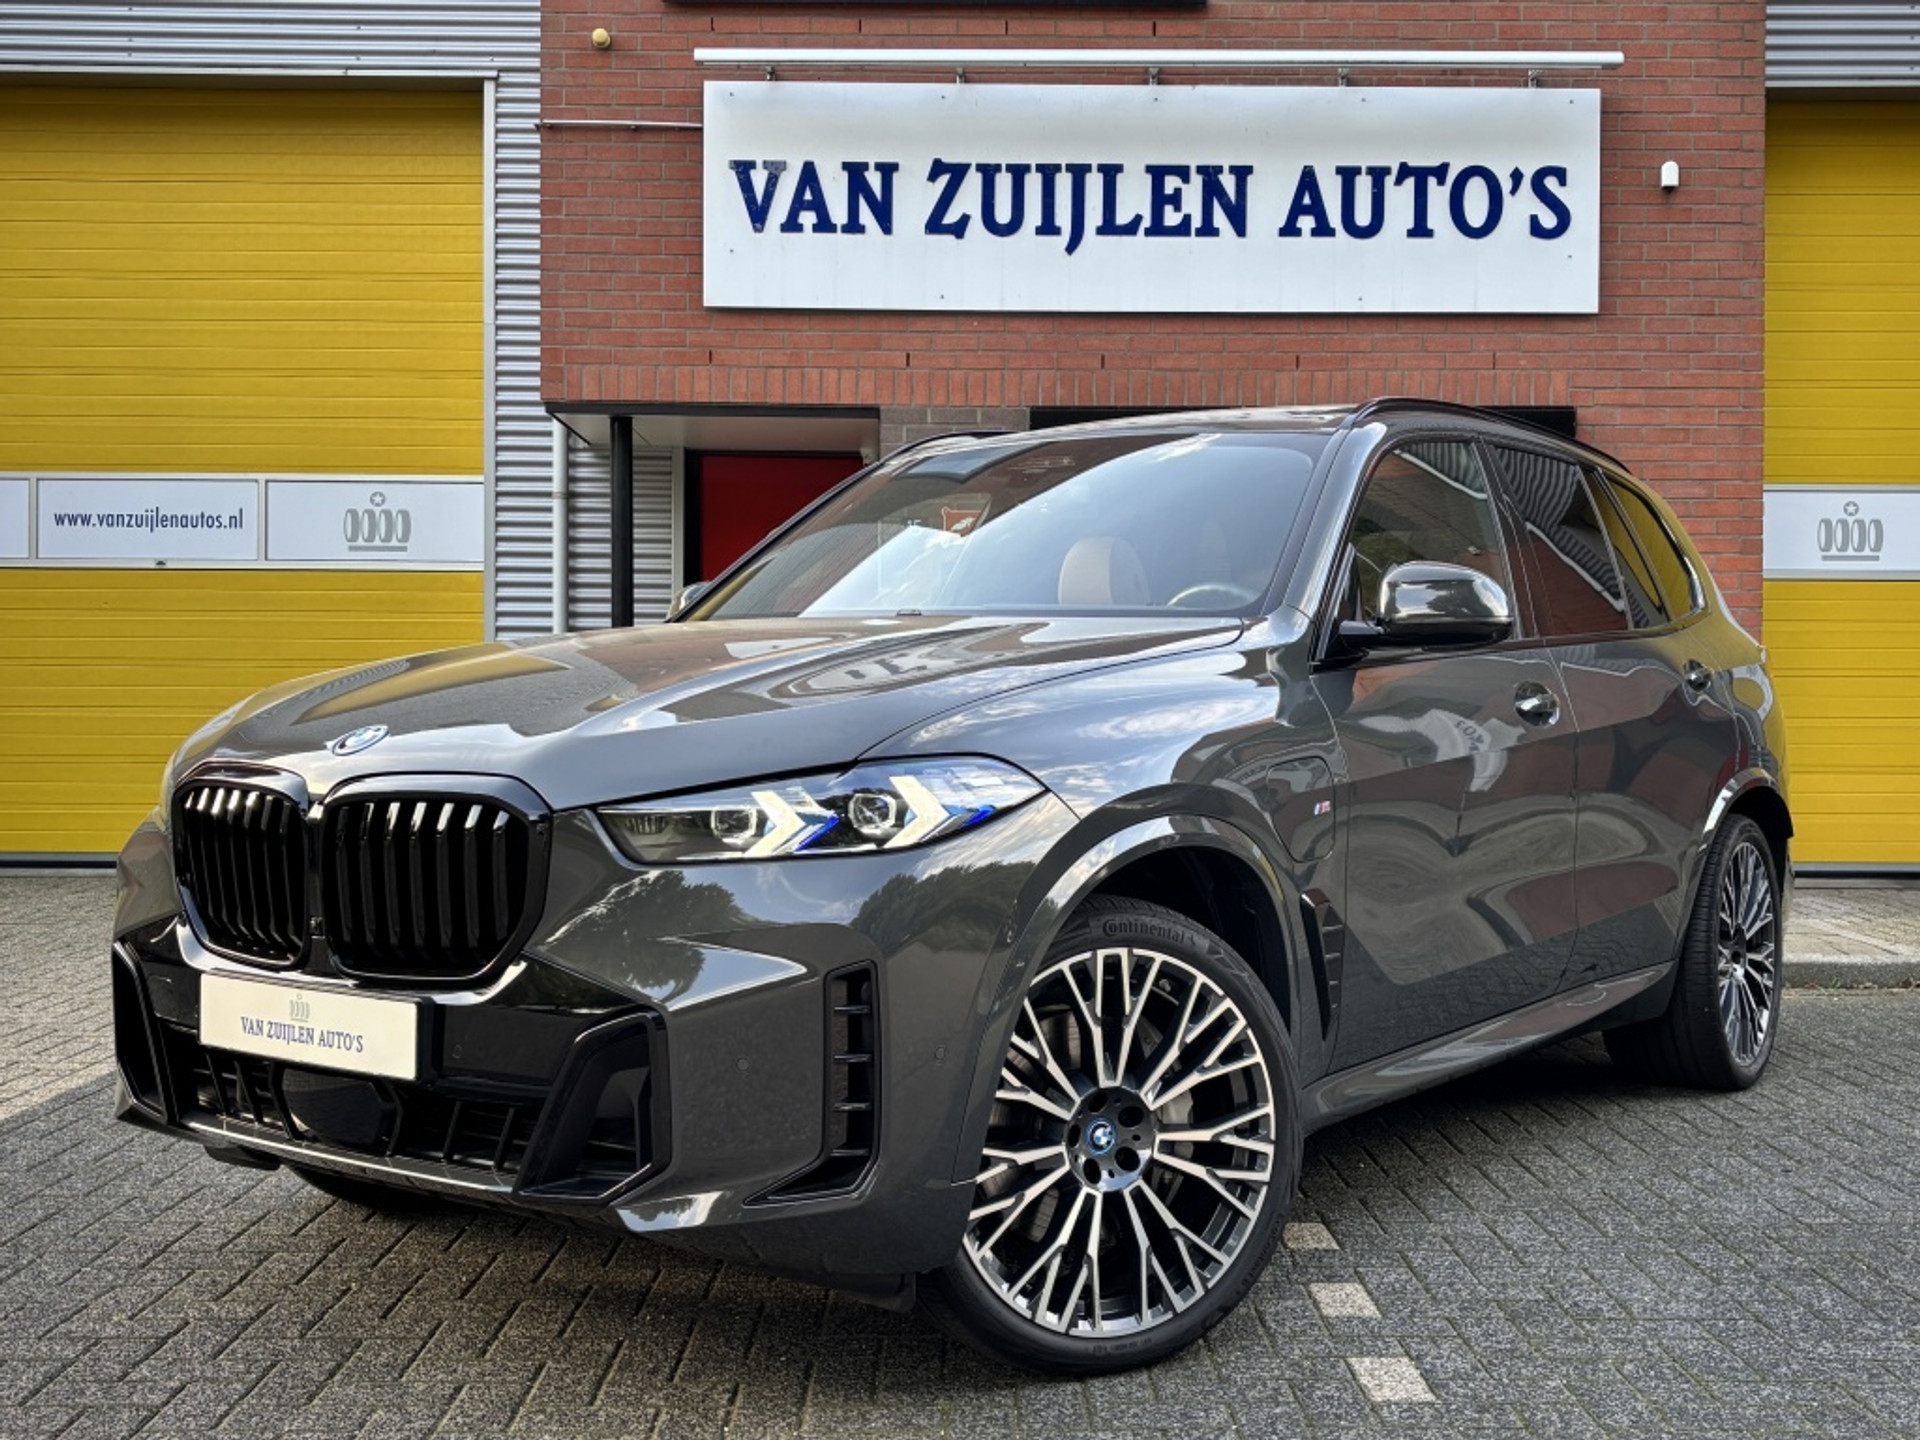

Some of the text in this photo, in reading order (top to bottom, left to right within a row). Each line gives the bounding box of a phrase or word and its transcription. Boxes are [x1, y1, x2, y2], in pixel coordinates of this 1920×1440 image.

[729, 157, 1573, 256] VAN ZUIJLEN AUTO'S
[53, 506, 245, 533] www.vanzuijlenautos.nl
[1103, 918, 1185, 944] Continental
[241, 1016, 364, 1053] VAN ZUIJLEN AUTO'S
